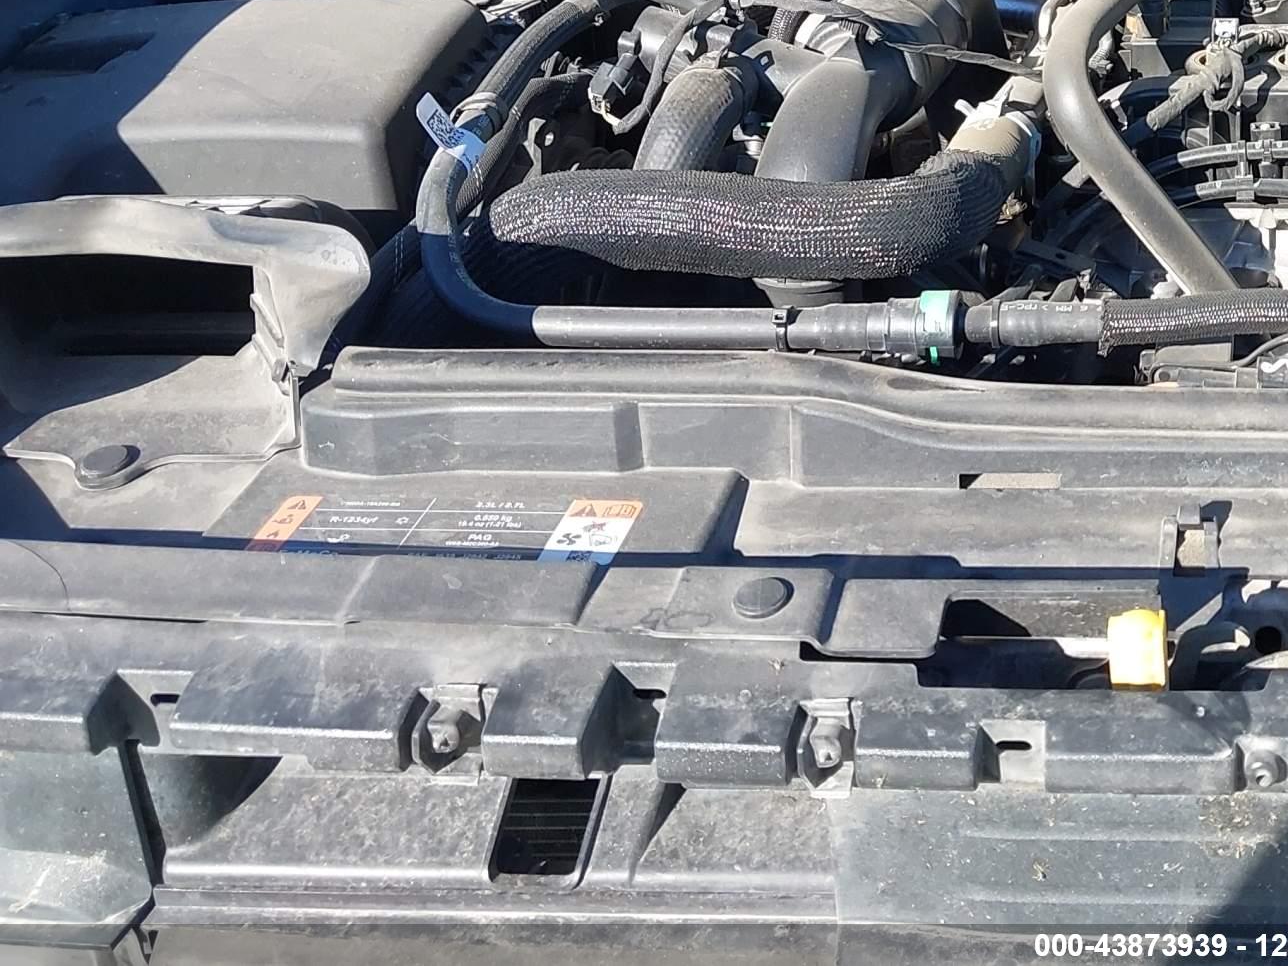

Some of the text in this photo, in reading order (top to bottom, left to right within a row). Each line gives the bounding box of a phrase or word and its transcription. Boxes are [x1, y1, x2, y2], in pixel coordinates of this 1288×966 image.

[329, 516, 379, 525] R-1234yf
[500, 515, 513, 523] kg
[467, 533, 492, 541] PAG
